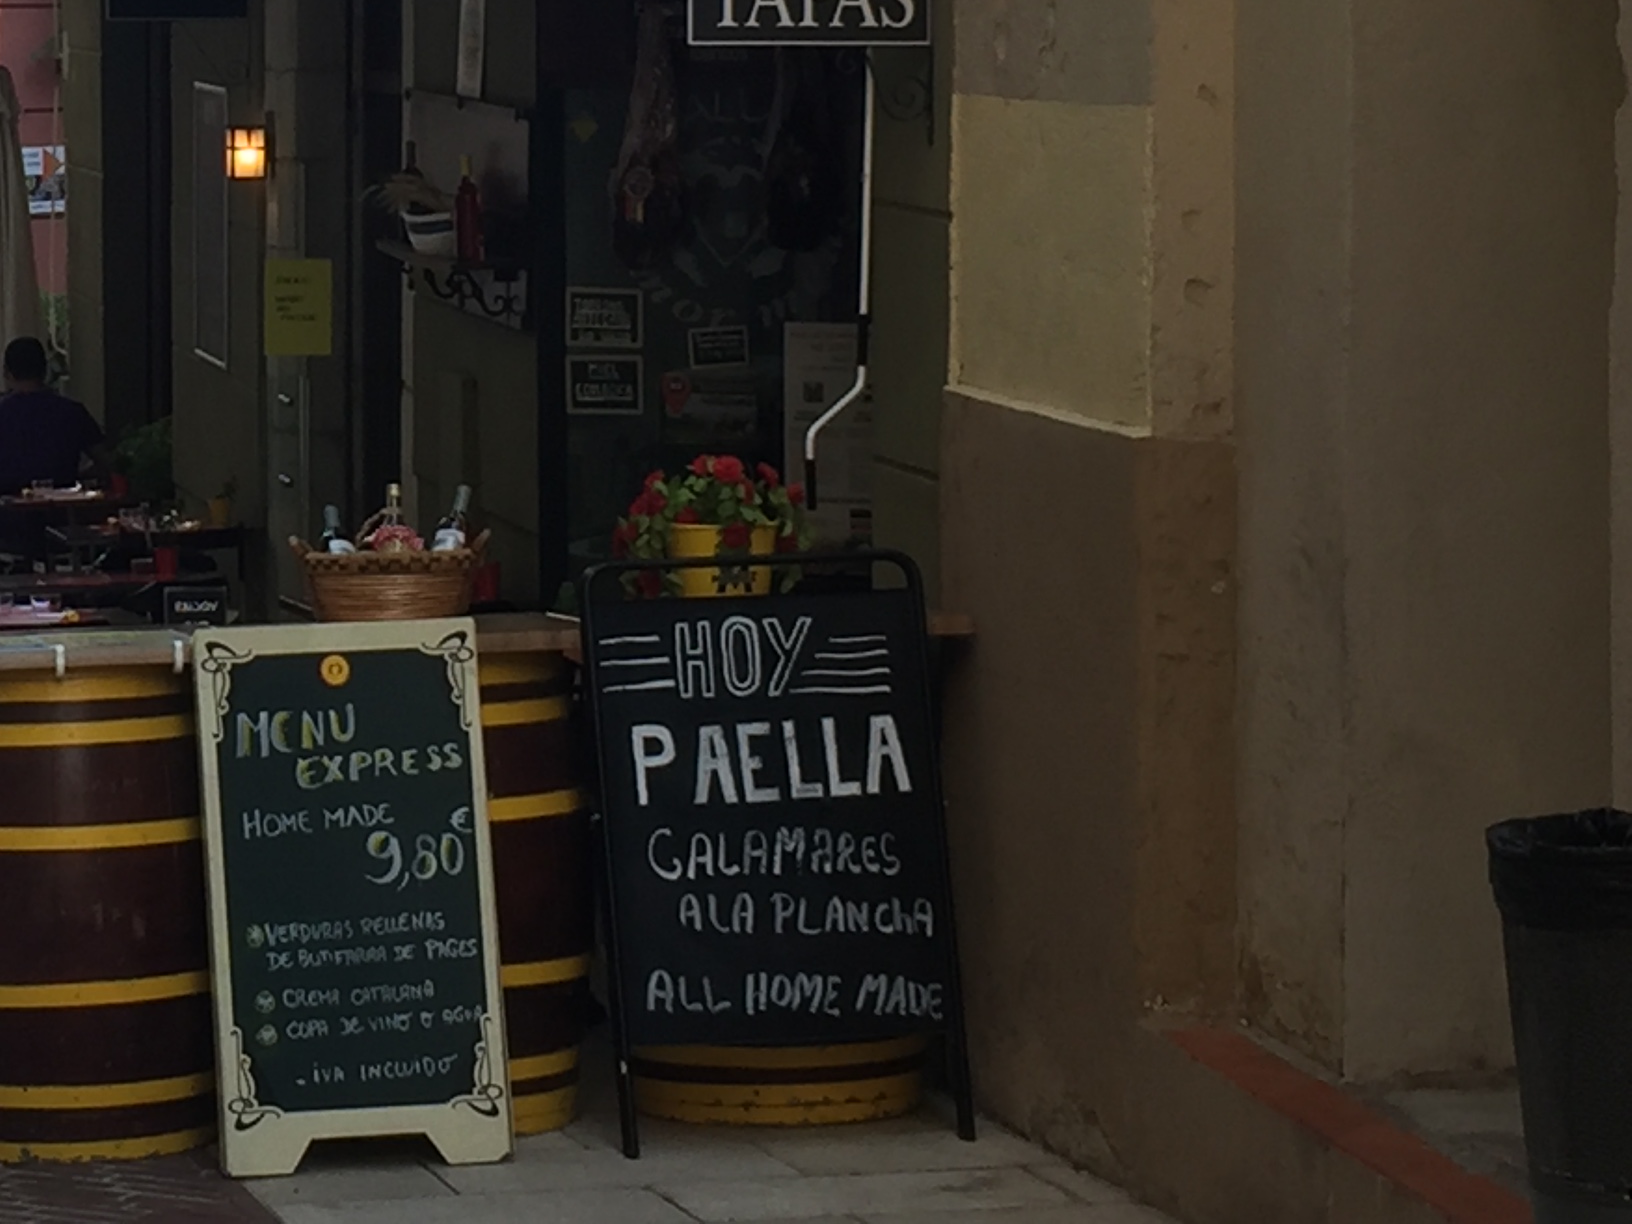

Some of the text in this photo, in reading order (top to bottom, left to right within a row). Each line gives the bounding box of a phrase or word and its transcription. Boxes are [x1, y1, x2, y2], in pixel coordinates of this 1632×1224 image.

[674, 615, 812, 698] HOY
[236, 702, 356, 759] MENU
[295, 742, 463, 790] EXPRESS
[631, 714, 912, 806] PAELLA
[242, 802, 395, 840] HOME MADE
[363, 829, 465, 892] 9,80
[647, 827, 901, 880] CALAMARES
[264, 919, 354, 947] VERDURAS
[266, 950, 294, 972] DE
[393, 943, 416, 963] DE
[282, 987, 339, 1009] CREMA
[646, 968, 944, 1020] ALL HOME MADE
[285, 1018, 329, 1040] COPA
[339, 1015, 365, 1036] DE
[367, 1011, 414, 1032] VINO
